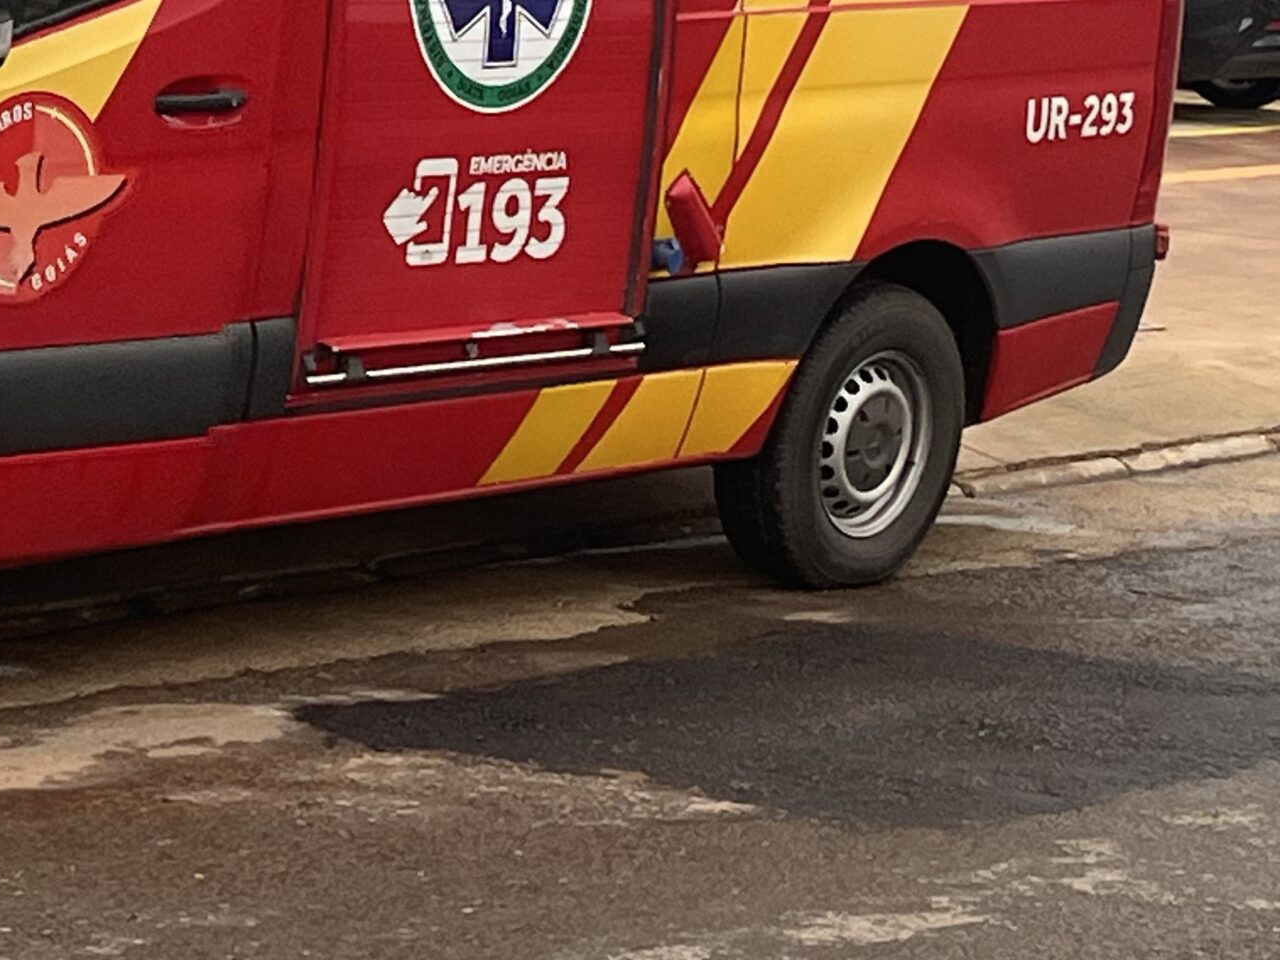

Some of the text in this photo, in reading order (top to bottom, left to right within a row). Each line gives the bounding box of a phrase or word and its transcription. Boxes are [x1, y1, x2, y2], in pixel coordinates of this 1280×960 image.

[1026, 92, 1135, 143] UR-293
[469, 149, 567, 175] EMERGÊNCIA
[455, 177, 570, 264] 193
